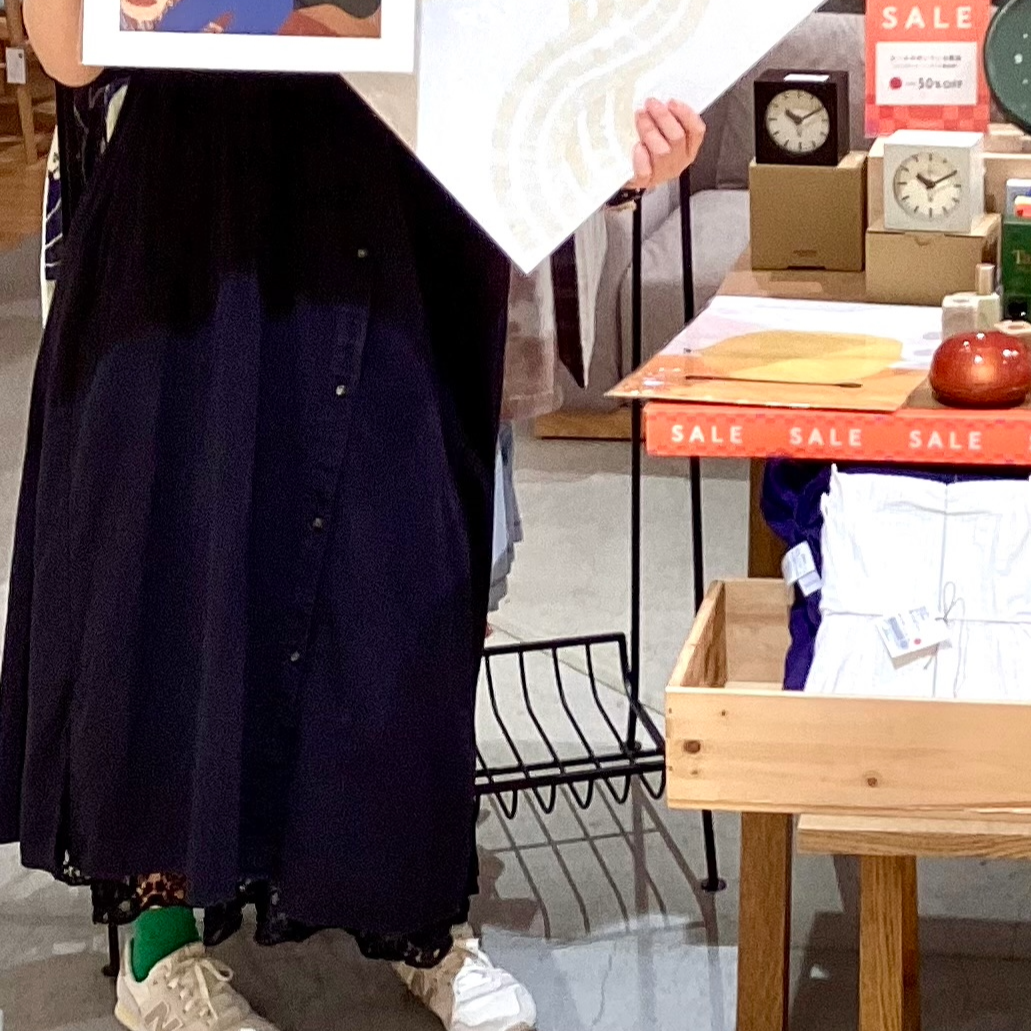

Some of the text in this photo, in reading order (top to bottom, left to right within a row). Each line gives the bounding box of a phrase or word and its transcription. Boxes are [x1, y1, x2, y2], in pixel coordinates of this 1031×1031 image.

[882, 6, 972, 29] SALE
[671, 425, 743, 444] SALE
[789, 427, 862, 447] SALE
[909, 430, 982, 450] SALE
